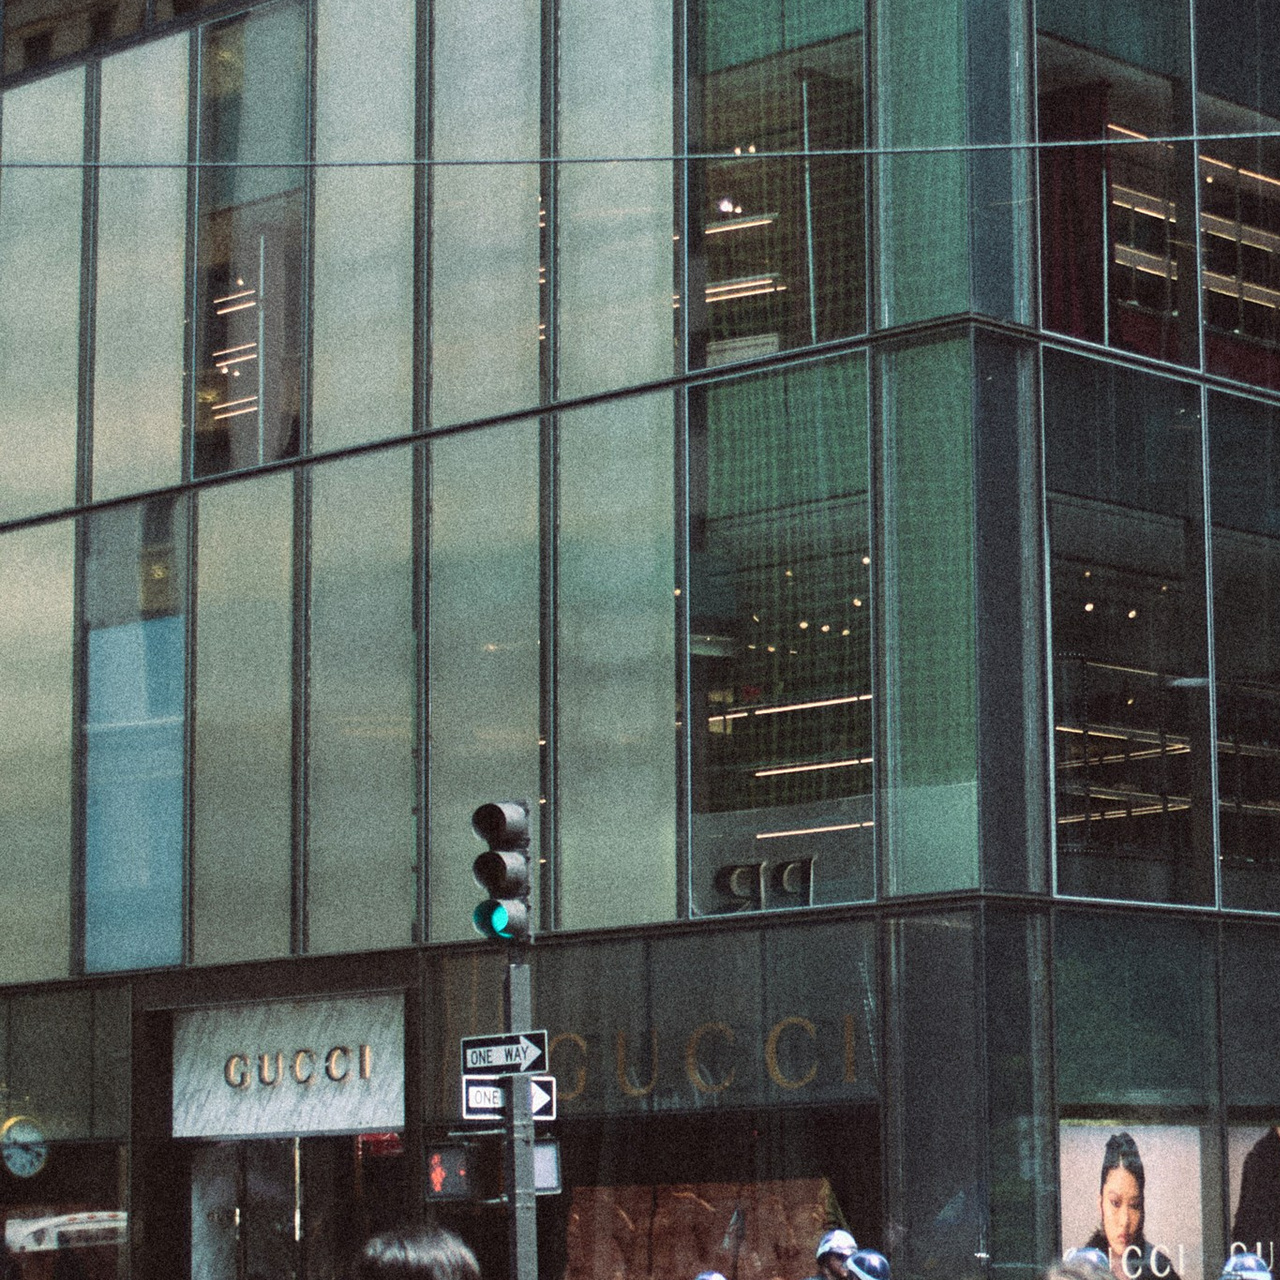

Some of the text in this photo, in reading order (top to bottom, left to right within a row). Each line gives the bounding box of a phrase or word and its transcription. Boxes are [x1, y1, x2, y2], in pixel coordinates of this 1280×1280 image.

[223, 1043, 373, 1090] GUCCI
[470, 1046, 529, 1066] ONE WAY
[549, 1013, 857, 1101] GUCCI
[474, 1090, 499, 1105] ONE
[1062, 1243, 1186, 1279] CCI
